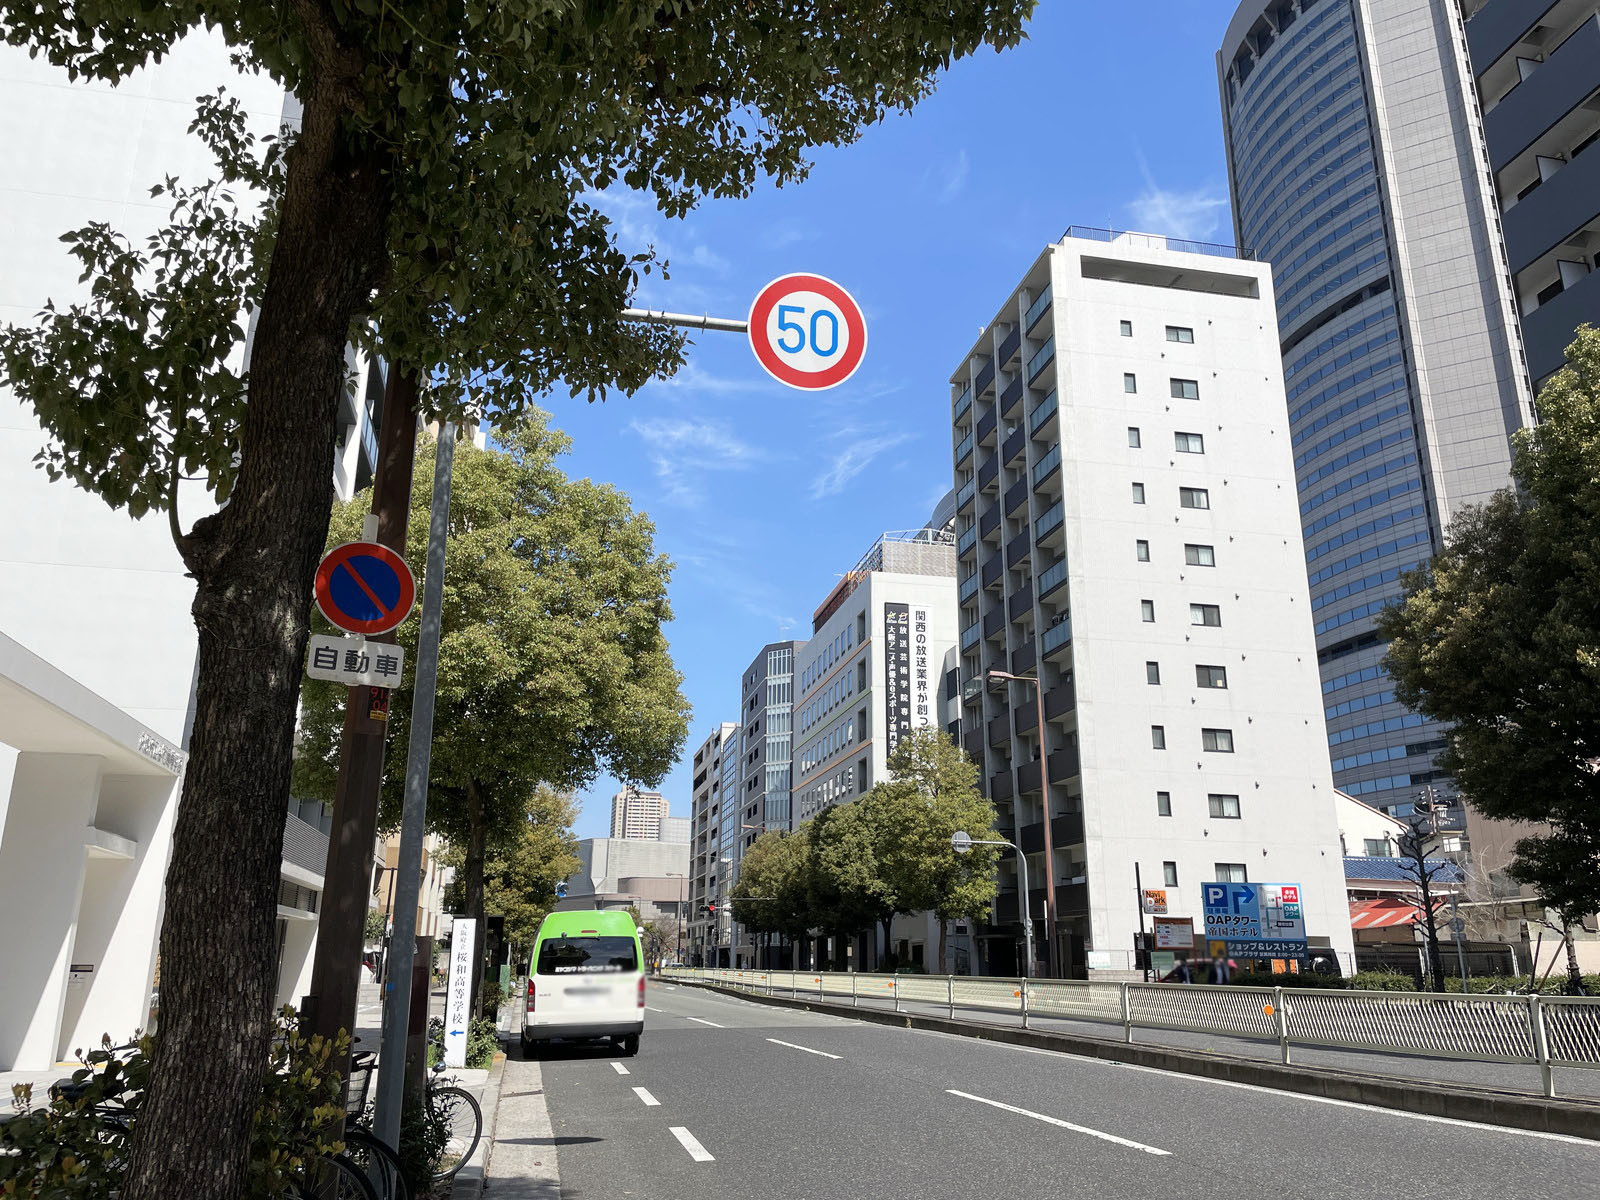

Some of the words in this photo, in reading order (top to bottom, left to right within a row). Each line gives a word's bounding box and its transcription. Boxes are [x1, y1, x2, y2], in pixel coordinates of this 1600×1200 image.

[778, 305, 838, 357] 50
[313, 646, 399, 677] 自動車
[1208, 887, 1224, 904] P
[1206, 915, 1258, 925] OAPタワー
[1208, 927, 1258, 937] 帝国ホテル
[1227, 942, 1304, 952] ショップ&レストラン
[452, 951, 468, 1025] 桜和高等学校
